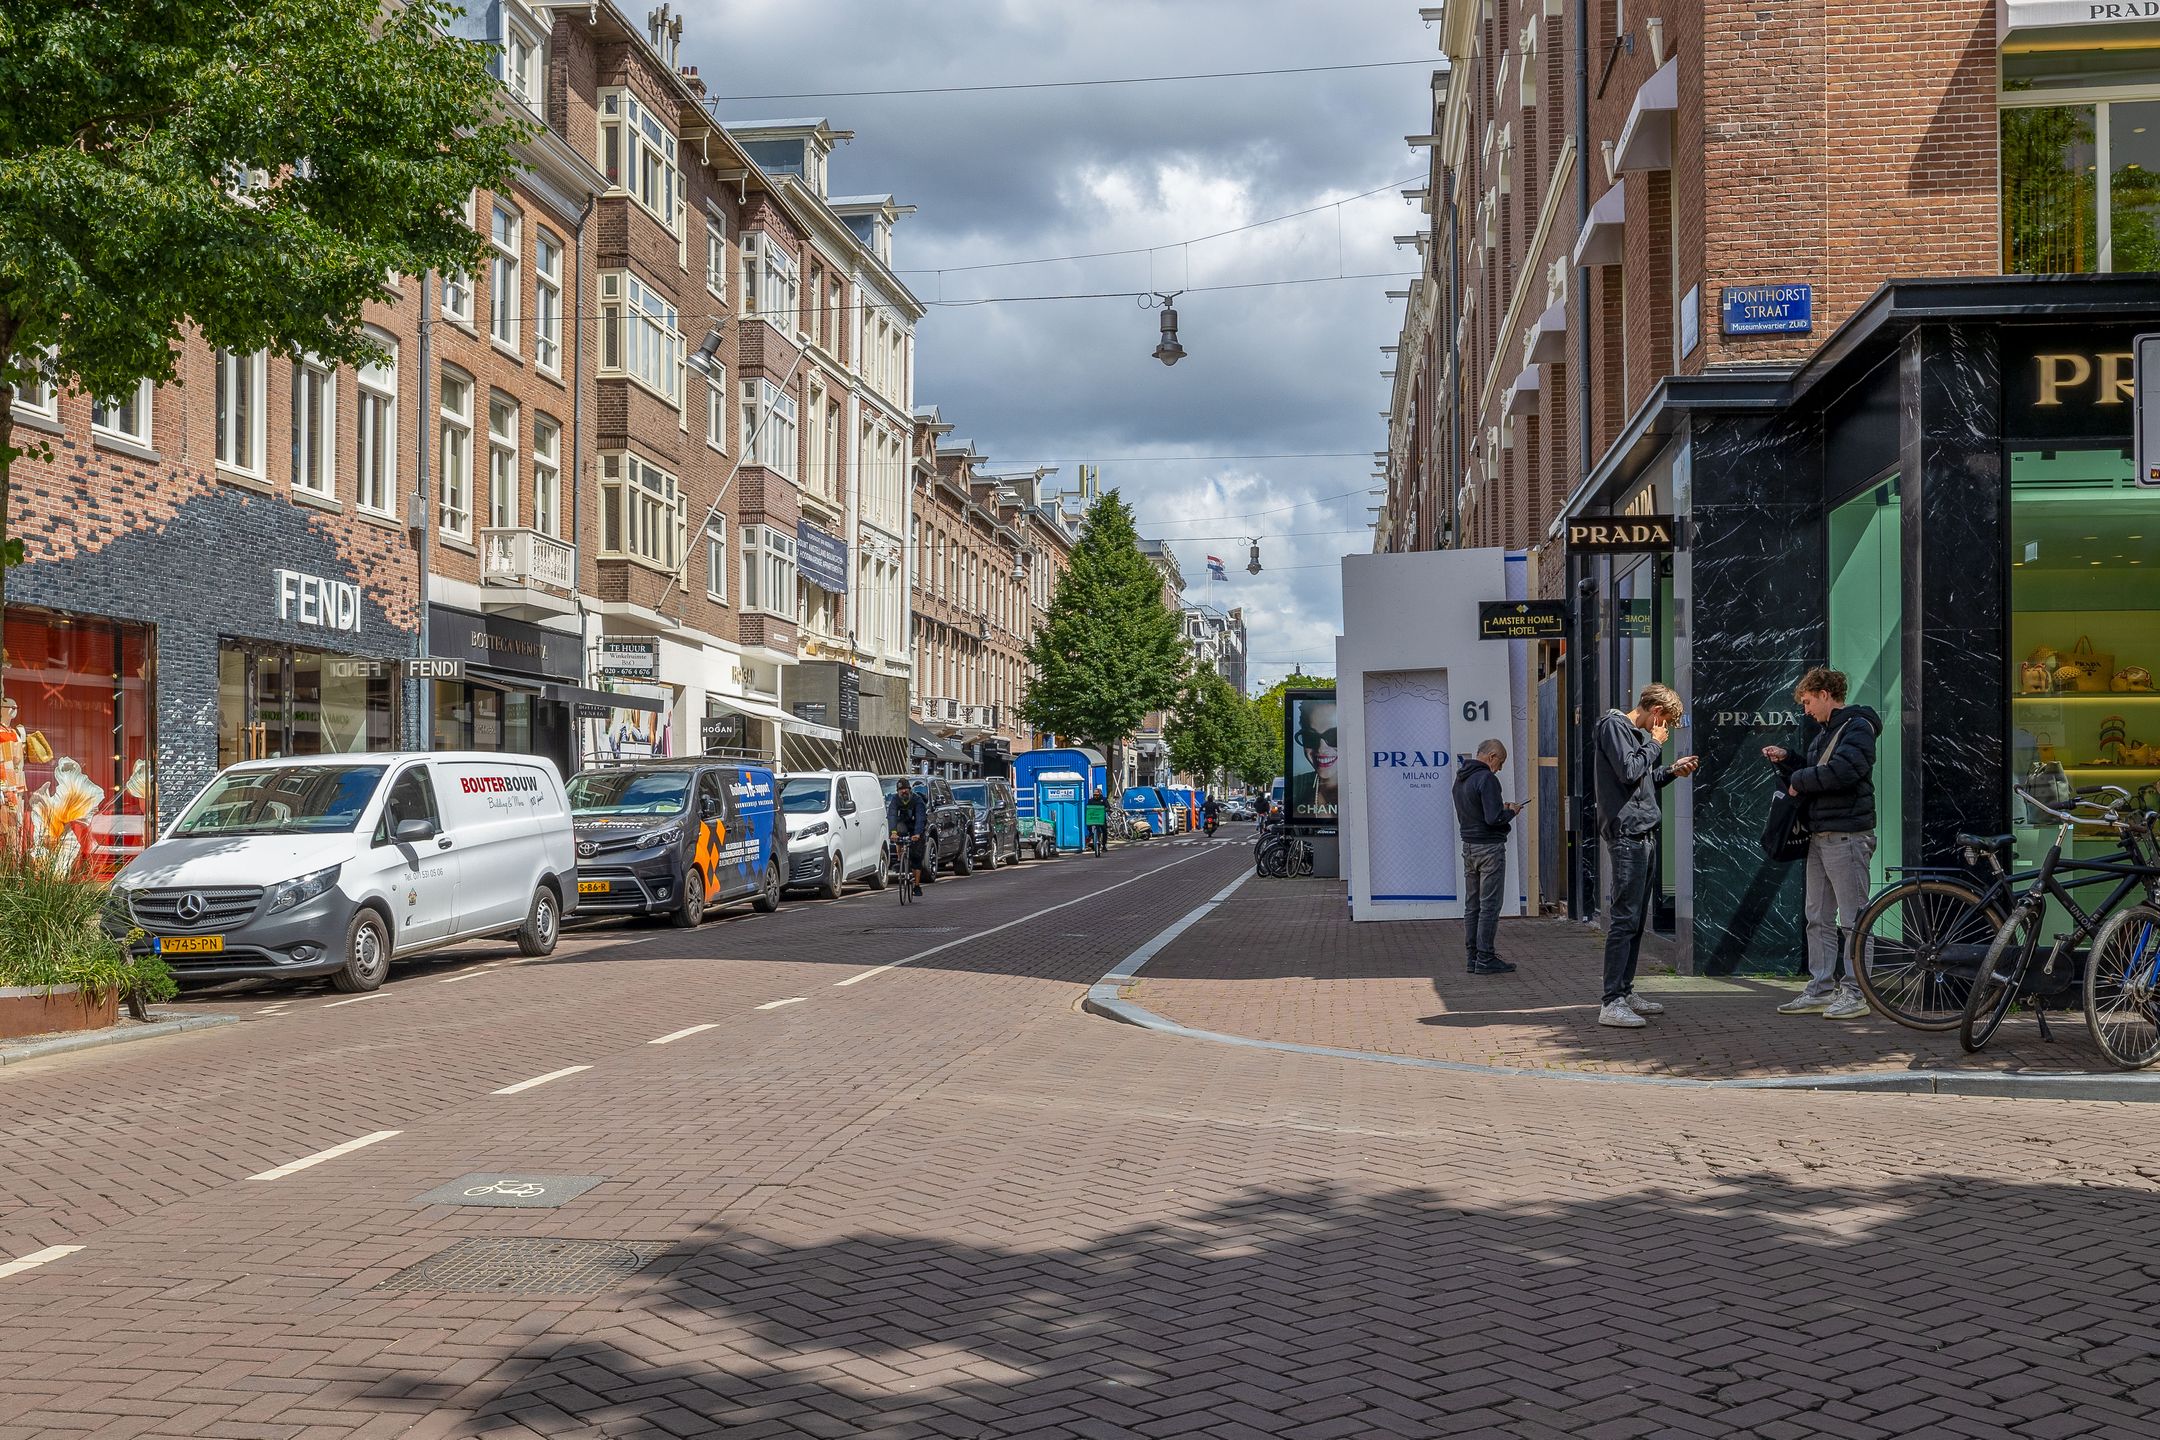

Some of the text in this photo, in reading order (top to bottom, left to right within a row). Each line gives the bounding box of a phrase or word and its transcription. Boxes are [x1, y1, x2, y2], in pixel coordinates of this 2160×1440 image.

[2090, 2, 2160, 19] PRAD
[1728, 288, 1807, 303] HONTHORST
[1744, 304, 1790, 318] STRAAT
[1732, 321, 1807, 331] Museumkwartier ZUID
[1570, 525, 1671, 544] PRADA
[273, 568, 361, 633] FENDI
[1492, 616, 1554, 625] AMSTER HOME
[1509, 627, 1537, 636] HOTEL
[471, 631, 513, 653] BOTTEGA
[609, 644, 620, 652] TE
[409, 660, 458, 678] FENDI
[1463, 700, 1489, 721] 61
[1717, 711, 1800, 727] PRADA
[1402, 772, 1439, 780] MILANO
[460, 776, 538, 794] BOUTERBOUW
[1296, 804, 1338, 815] CHAN
[2069, 905, 2094, 930] UNION
[164, 938, 218, 951] V-745-PN
